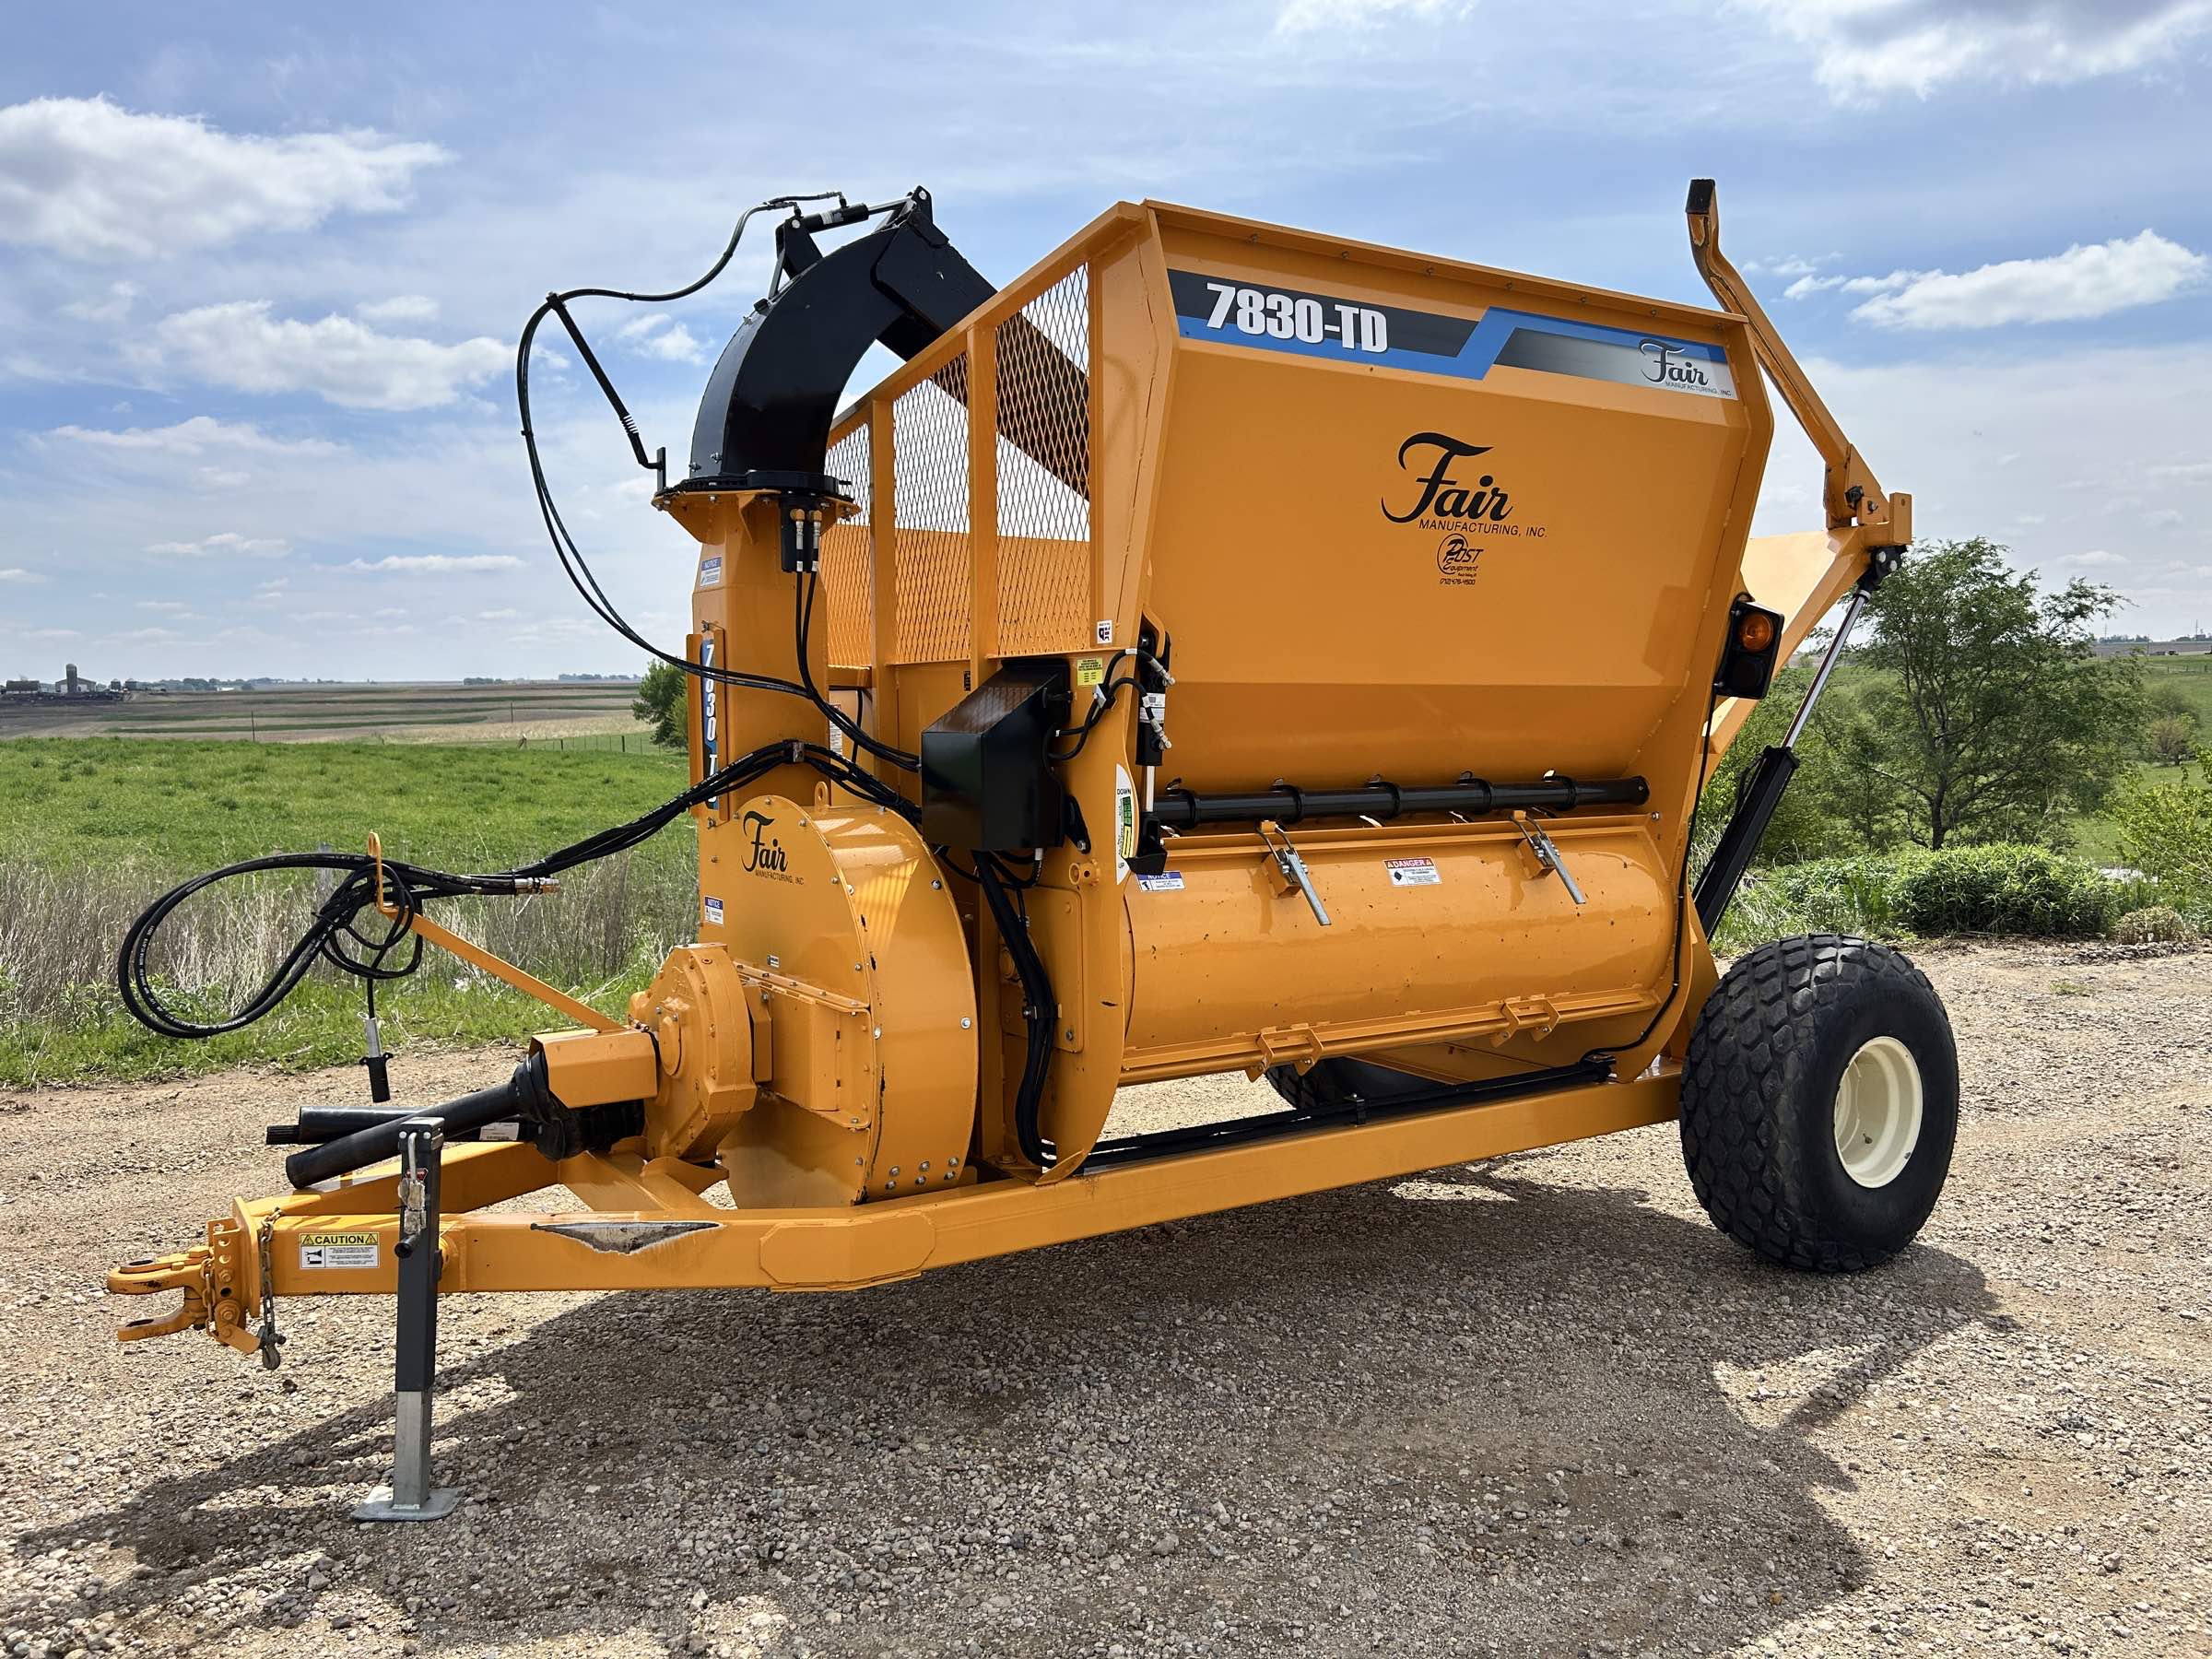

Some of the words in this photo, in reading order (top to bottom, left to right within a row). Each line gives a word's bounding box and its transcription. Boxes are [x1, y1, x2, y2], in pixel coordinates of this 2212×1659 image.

[1206, 282, 1388, 354] 7830-TD
[1639, 337, 1709, 385] Fair
[1381, 431, 1513, 524] Fair
[1418, 518, 1522, 536] MANUFACTURING,
[1525, 526, 1547, 538] INC.
[741, 810, 788, 872] Fair
[1393, 859, 1425, 868] DANGER
[314, 1235, 364, 1244] CAUTION
